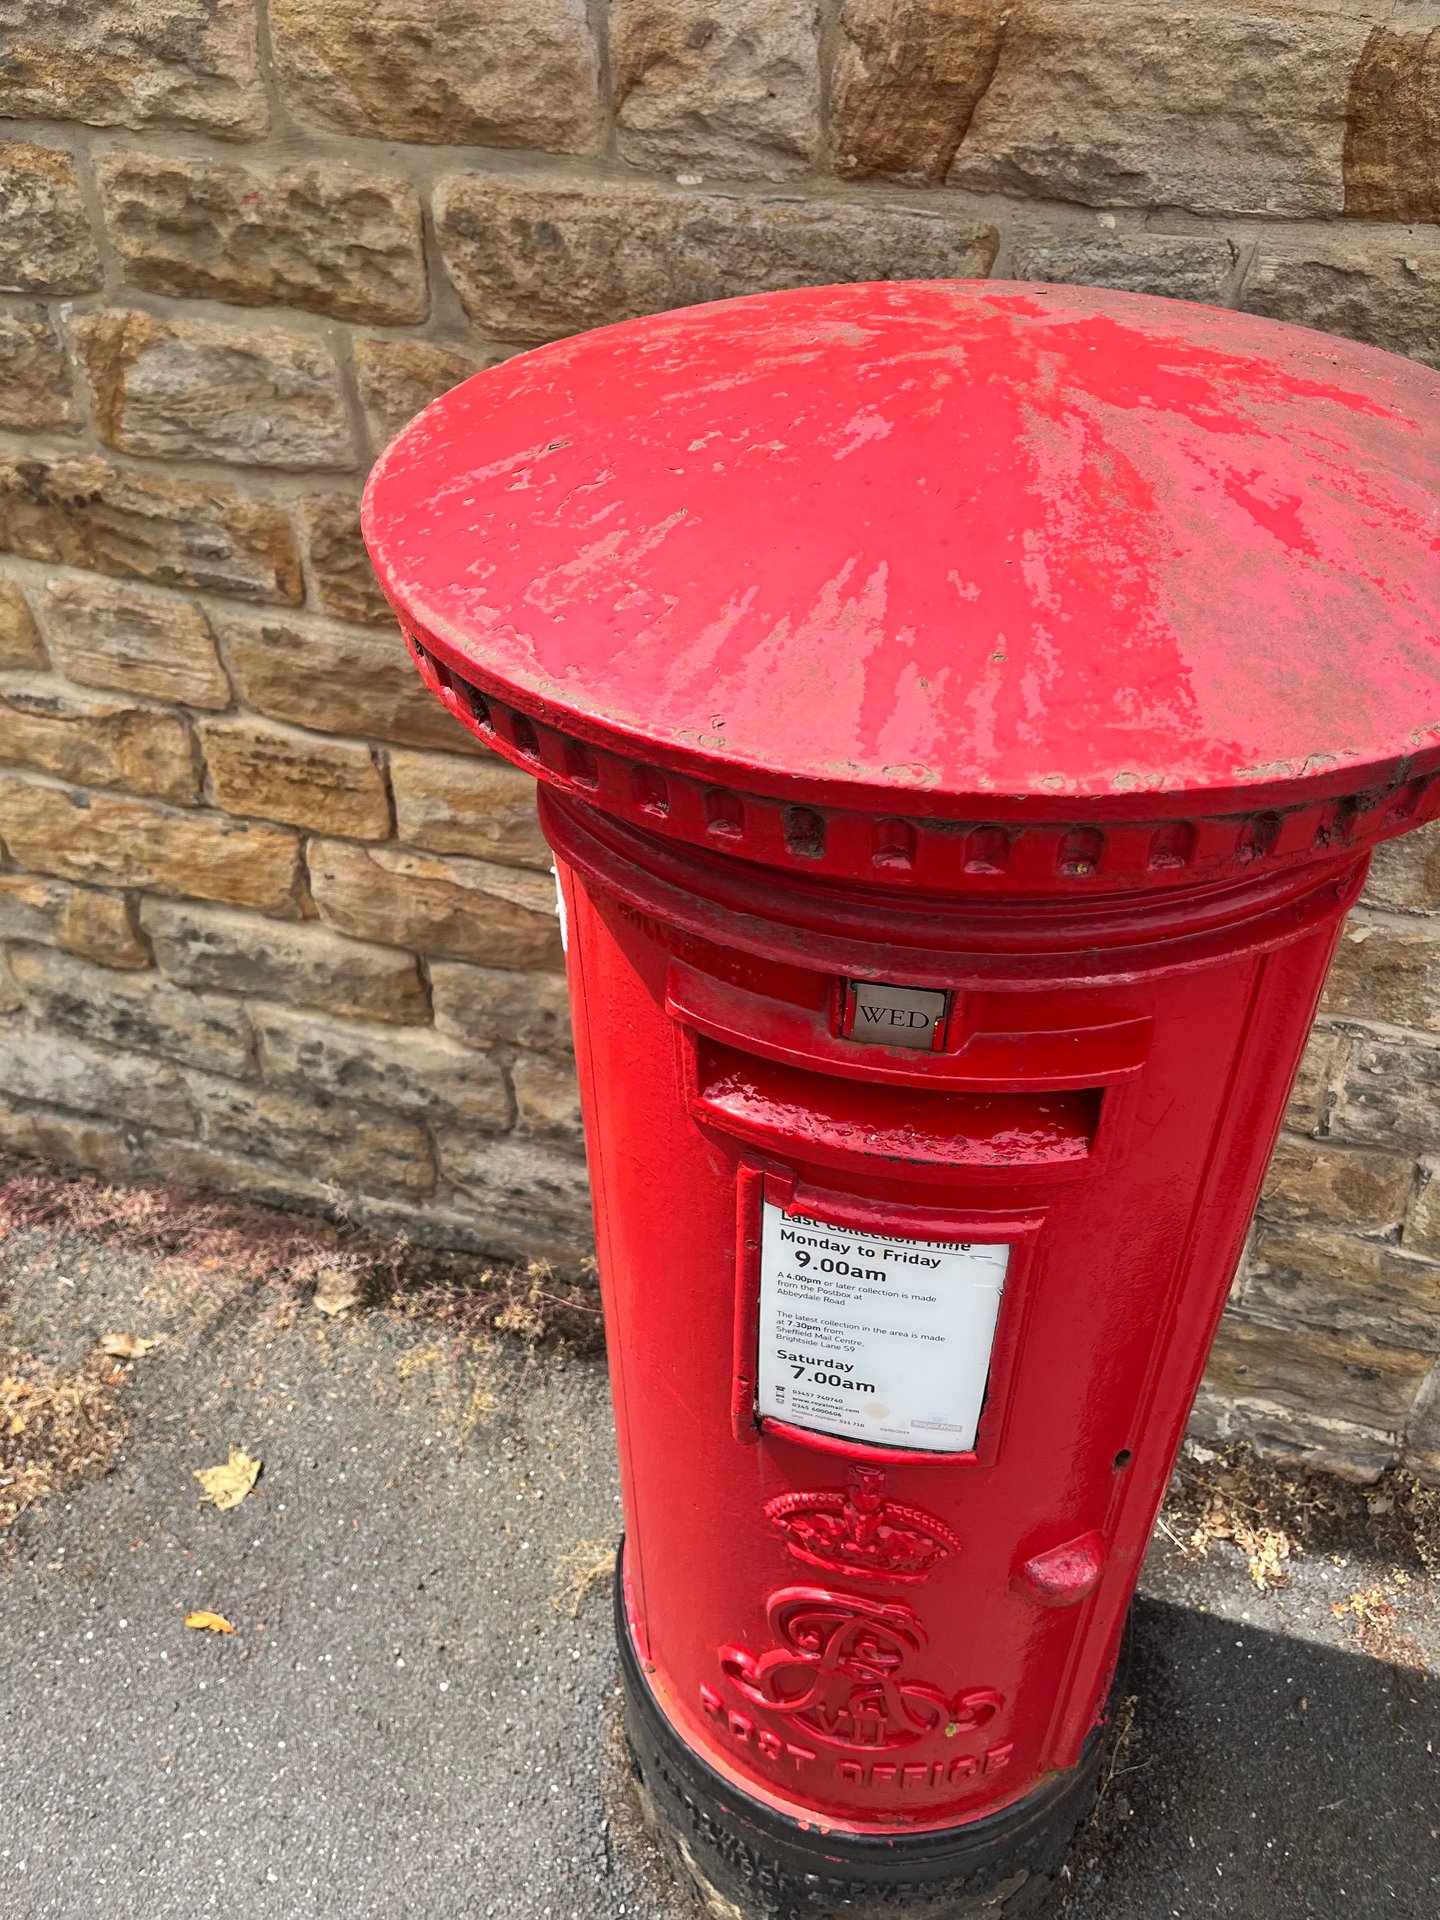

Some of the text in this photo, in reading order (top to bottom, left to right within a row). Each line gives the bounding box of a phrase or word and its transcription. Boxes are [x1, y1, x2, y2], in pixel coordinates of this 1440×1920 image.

[860, 1005, 930, 1029] WED
[827, 1223, 917, 1245] coecon
[780, 1228, 942, 1269] Monday to Friday
[794, 1250, 887, 1282] 9.00am
[776, 1271, 937, 1303] A 4.00pm or later collection is made
[776, 1279, 863, 1301] from the Postbox at
[776, 1287, 846, 1306] Abbeydale Road
[776, 1310, 793, 1319] The
[795, 1313, 818, 1324] latest
[820, 1319, 860, 1331] collection
[862, 1325, 871, 1333] in
[872, 1327, 887, 1335] the
[889, 1330, 909, 1338] area
[920, 1334, 946, 1342] made
[776, 1325, 865, 1348] Sheffield Mail Centre,
[787, 1319, 821, 1332] 7.30pm
[823, 1327, 845, 1336] from
[776, 1333, 856, 1353] Brightside Lane S9
[777, 1349, 855, 1373] Saturday
[790, 1364, 876, 1394] 7.00am
[791, 1397, 860, 1414] www.royalmail.com
[791, 1402, 810, 1411] 0345
[792, 1389, 844, 1404] 03457 740740
[911, 1420, 961, 1432] Royal Mail
[700, 1682, 1014, 1790] POST OFFICE
